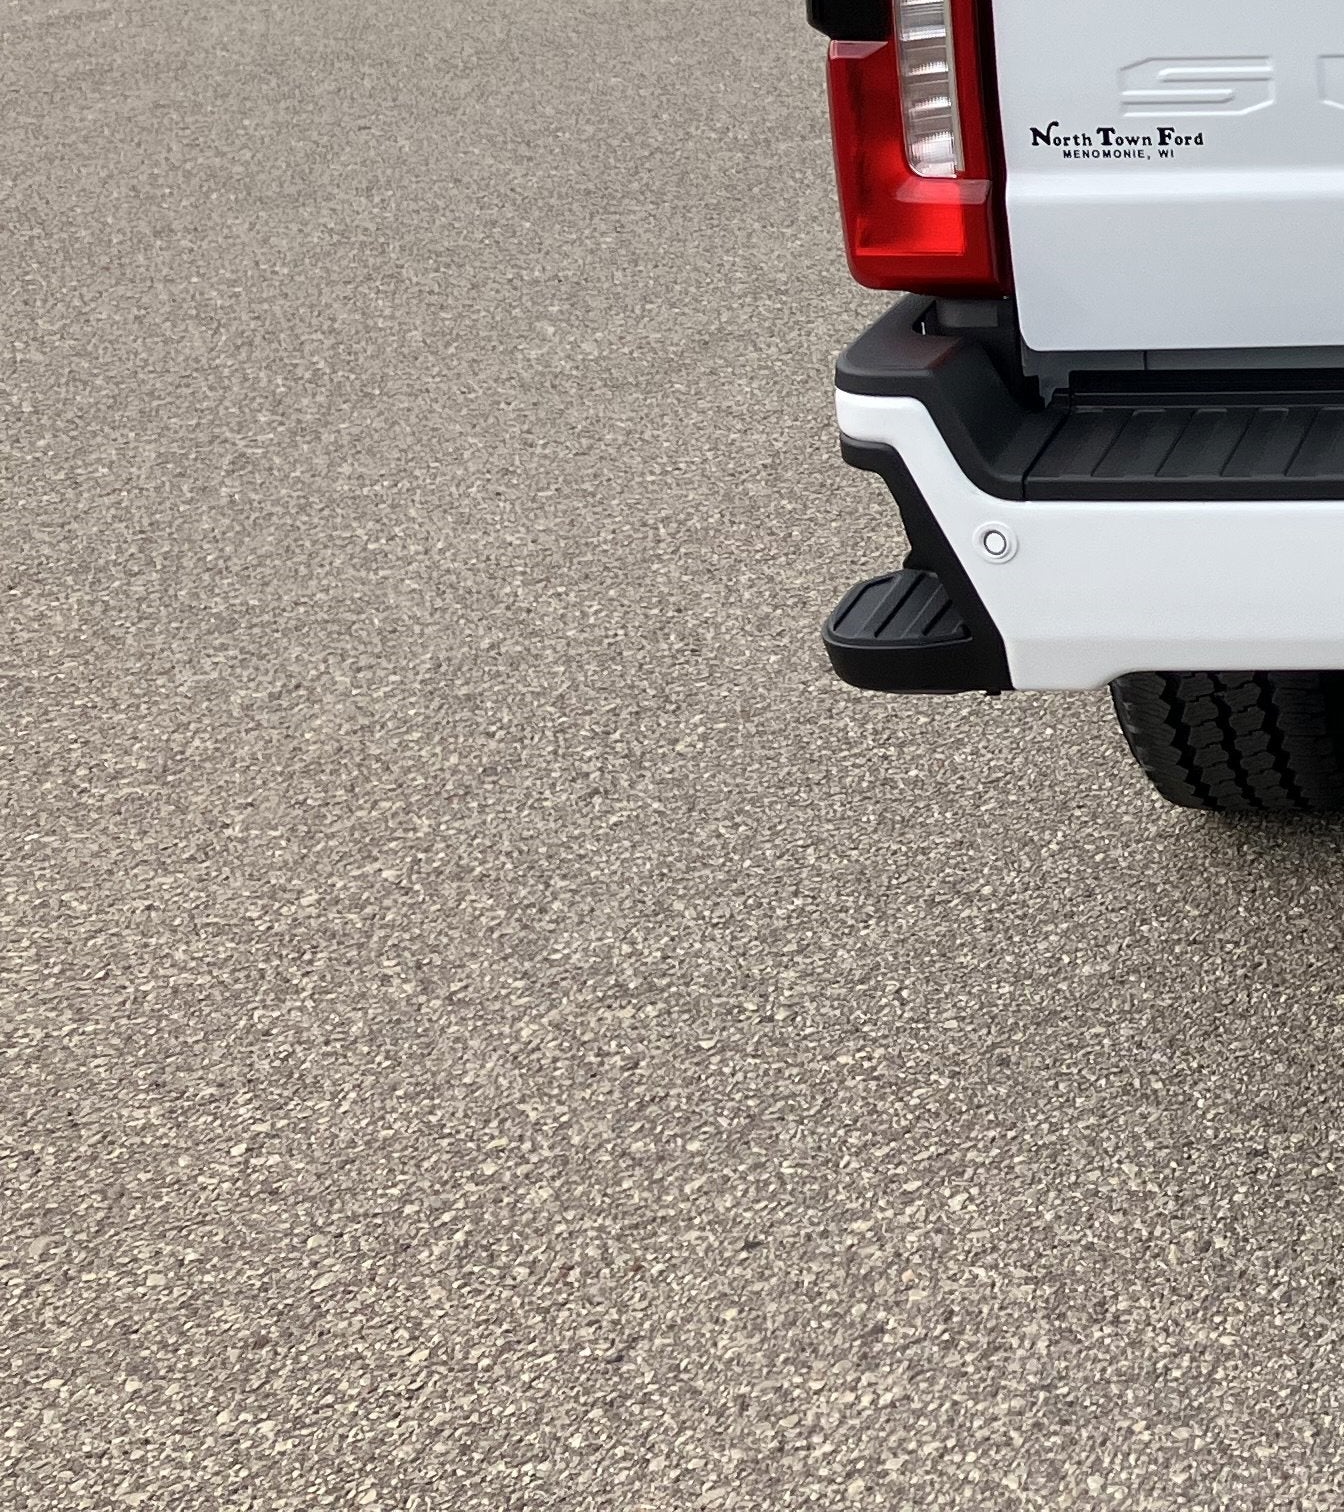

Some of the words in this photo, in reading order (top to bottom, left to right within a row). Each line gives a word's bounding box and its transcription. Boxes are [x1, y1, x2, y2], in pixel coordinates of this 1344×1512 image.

[1029, 121, 1093, 147] North
[1096, 127, 1153, 147] Town
[1156, 127, 1204, 146] Ford
[1063, 149, 1151, 160] MENOMONIE,
[1158, 149, 1174, 159] WI
